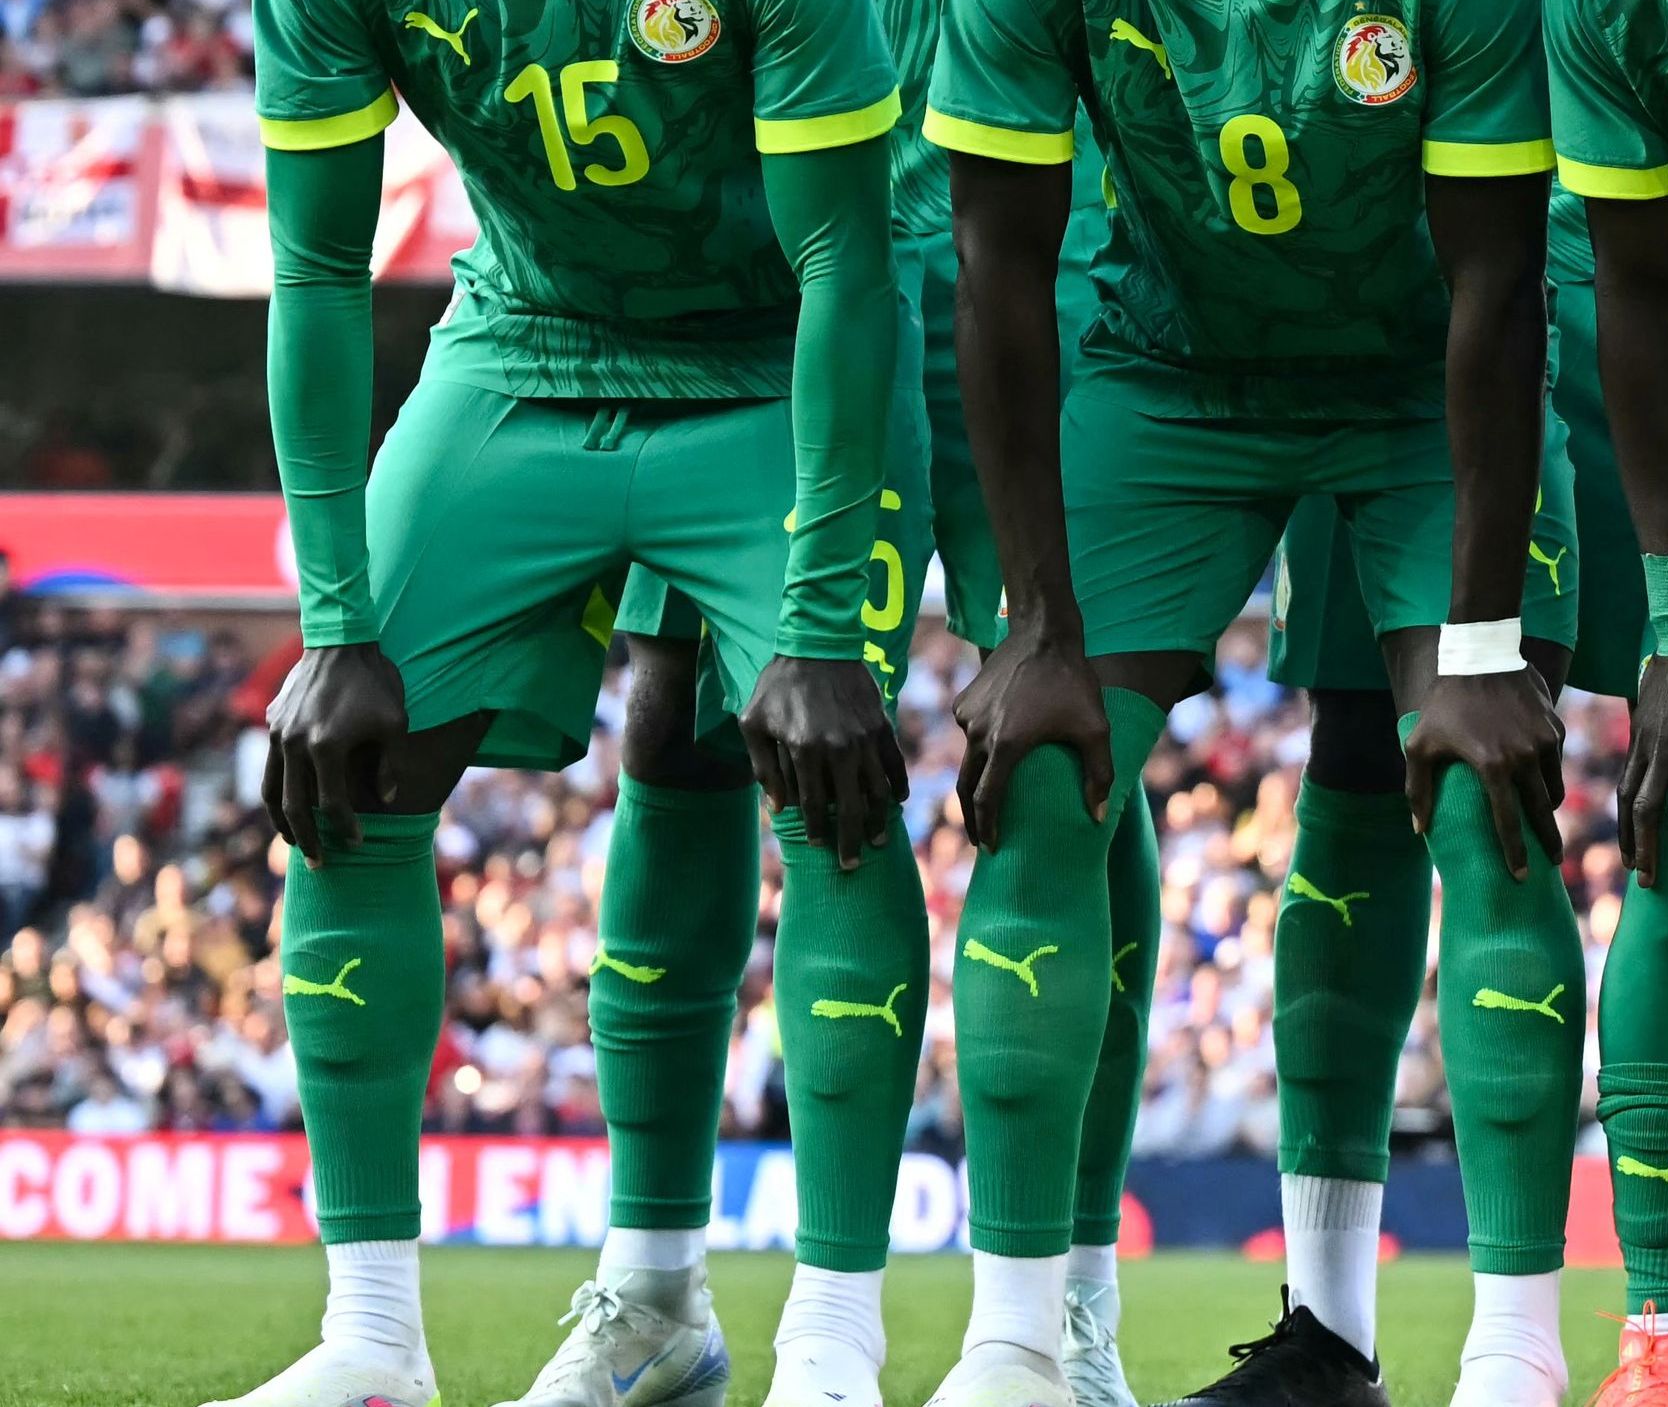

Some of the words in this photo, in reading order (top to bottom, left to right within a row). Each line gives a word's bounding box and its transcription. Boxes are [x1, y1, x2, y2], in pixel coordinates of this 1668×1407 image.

[503, 59, 650, 191] 15
[1219, 113, 1303, 235] 8
[0, 1141, 284, 1240] COME
